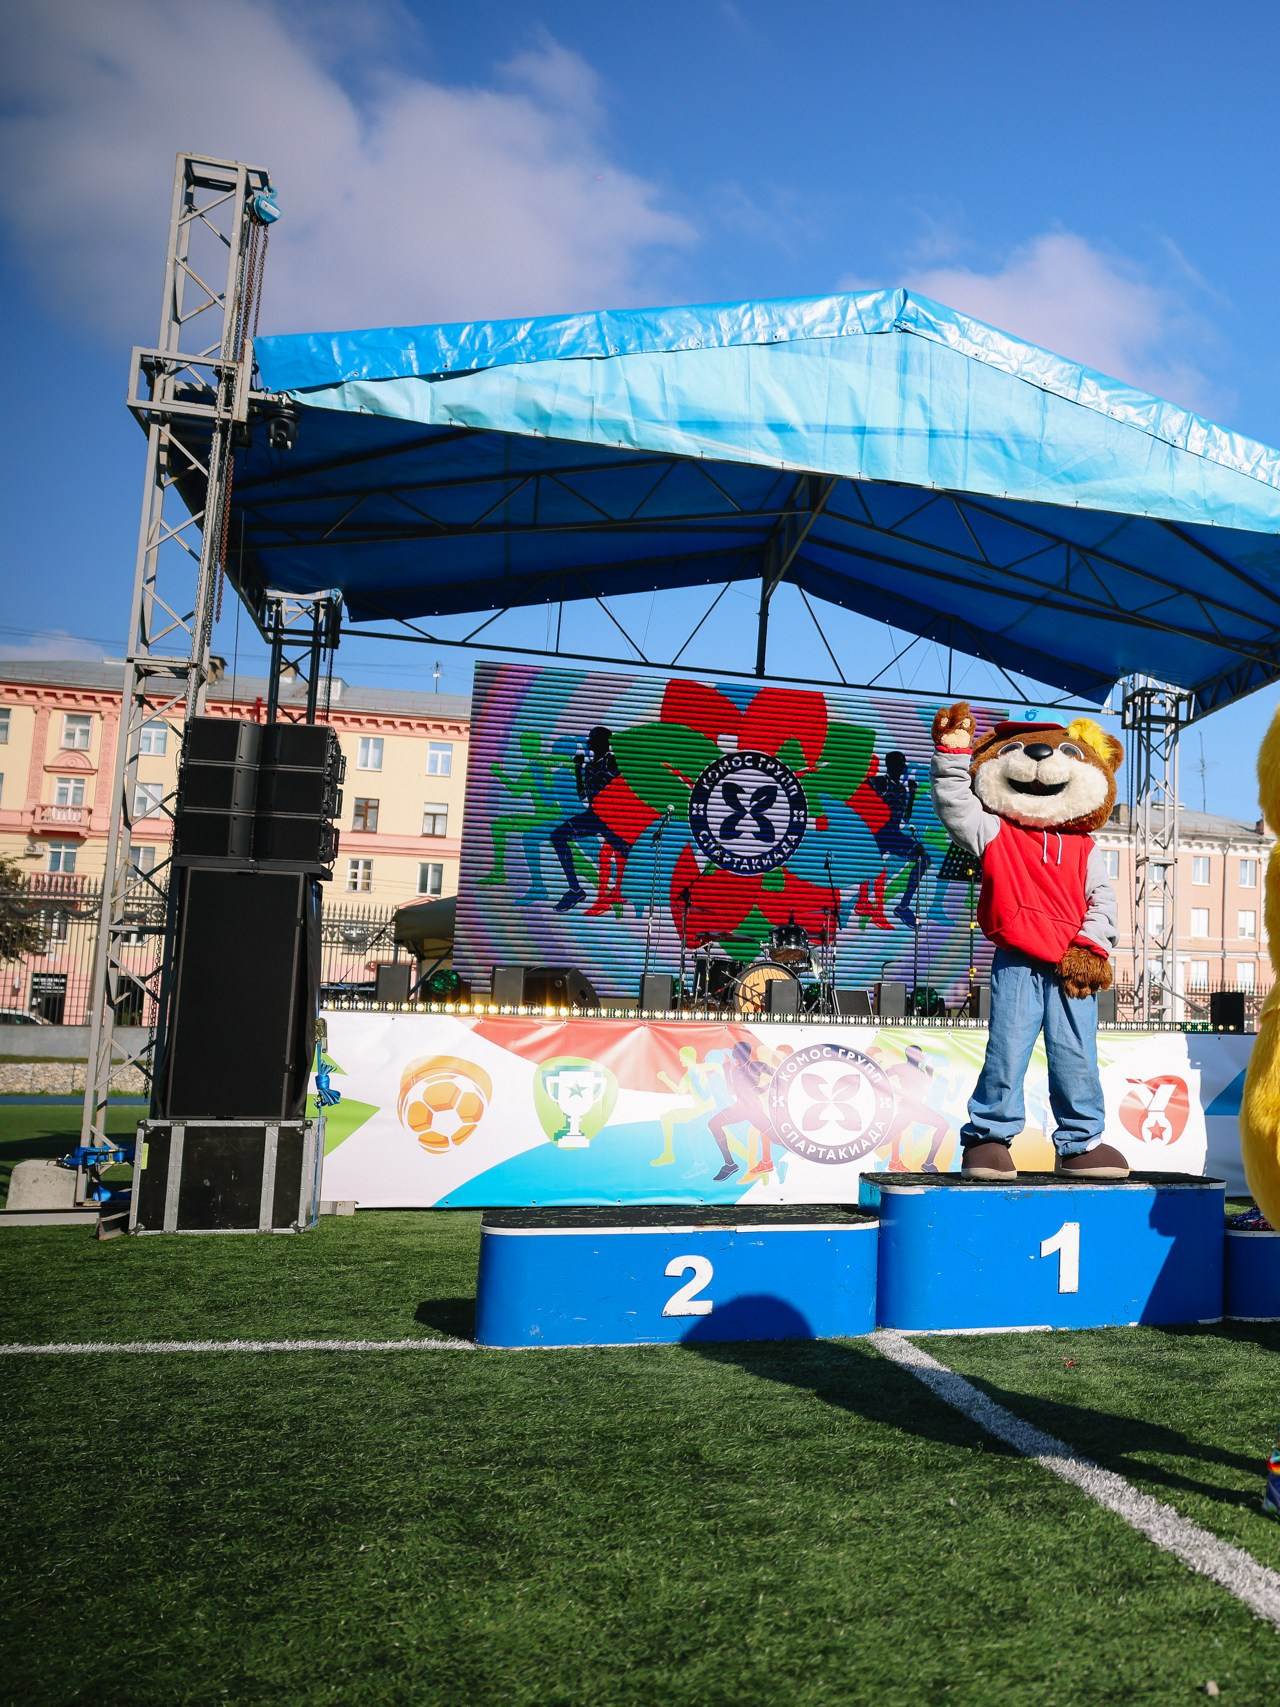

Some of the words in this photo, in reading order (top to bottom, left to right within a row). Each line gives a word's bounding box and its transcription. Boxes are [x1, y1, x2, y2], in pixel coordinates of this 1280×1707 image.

[702, 755, 753, 790] КОМОС
[758, 757, 799, 796] ГРУПП
[698, 830, 799, 870] СПАРТАКИАДА
[778, 1046, 832, 1083] КОМОС
[837, 1048, 884, 1084] ГРУПП
[780, 1121, 886, 1161] СПАРТАКИАДА
[1039, 1221, 1081, 1294] 1
[661, 1254, 715, 1318] 2
